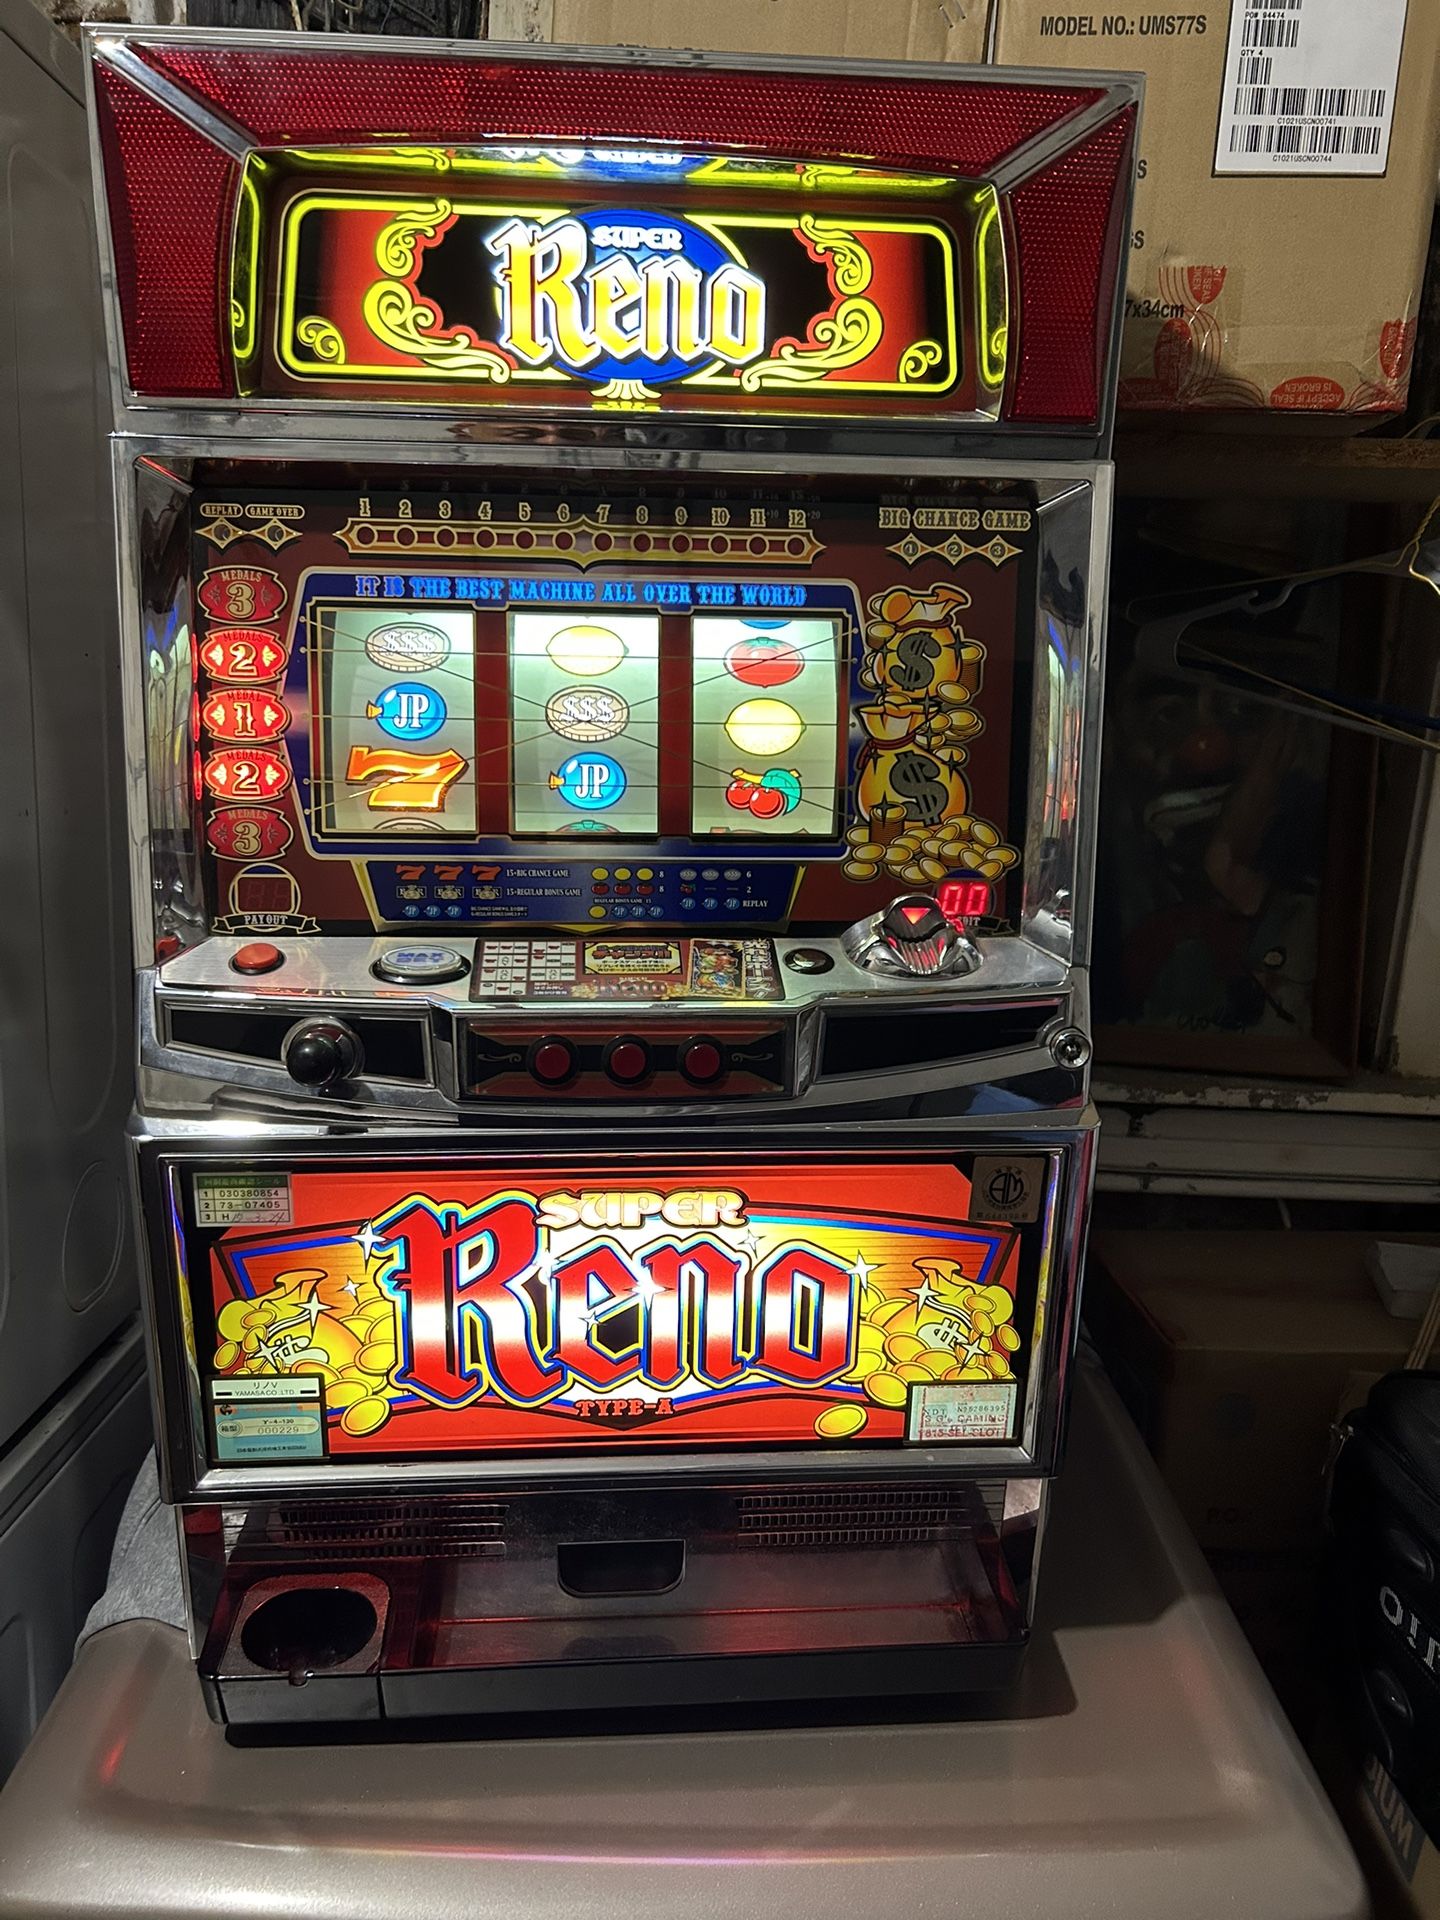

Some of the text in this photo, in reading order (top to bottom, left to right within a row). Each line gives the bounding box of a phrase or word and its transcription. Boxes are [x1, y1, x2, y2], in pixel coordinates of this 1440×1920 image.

[1039, 14, 1207, 36] MODEL NO.: UMS77S
[591, 225, 685, 251] SUPER
[486, 217, 767, 367] Reno
[205, 505, 239, 516] REPLAY
[249, 506, 299, 517] GAME OVER
[360, 498, 371, 517] 1
[398, 499, 412, 518] 2
[438, 500, 452, 519] 3
[478, 501, 492, 520] 4
[518, 502, 532, 521] 5
[556, 503, 570, 522] 6
[595, 504, 611, 523] 7
[635, 504, 649, 525] 8
[674, 505, 689, 525] 9
[711, 507, 731, 527] 10
[750, 507, 767, 528] 11
[788, 508, 807, 528] 12
[879, 507, 1031, 531] BIG CHANCE GAME
[220, 570, 263, 583] MEDALS
[226, 580, 256, 619] 3
[355, 575, 807, 607] IT IS THE BEST MACHINE ALL OVER THE WORLD
[222, 630, 265, 643] MEDALS
[228, 641, 258, 677] 2
[227, 691, 263, 703] MEDAL
[233, 701, 257, 737] 1
[392, 692, 430, 730] JP
[226, 750, 267, 763] MEDALS
[231, 760, 261, 796] 2
[574, 763, 609, 799] JP
[227, 808, 269, 822] MEDALS
[232, 820, 262, 856] 3
[528, 869, 552, 878] CHANCE
[553, 869, 570, 878] GAME
[941, 885, 989, 916] 00
[244, 914, 289, 926] PAYOUT
[219, 1189, 279, 1199] 030380854
[220, 1201, 281, 1209] 73-07405
[535, 1188, 749, 1229] SUPER
[375, 1191, 860, 1408] Reno
[575, 1398, 674, 1417] TYPE-A
